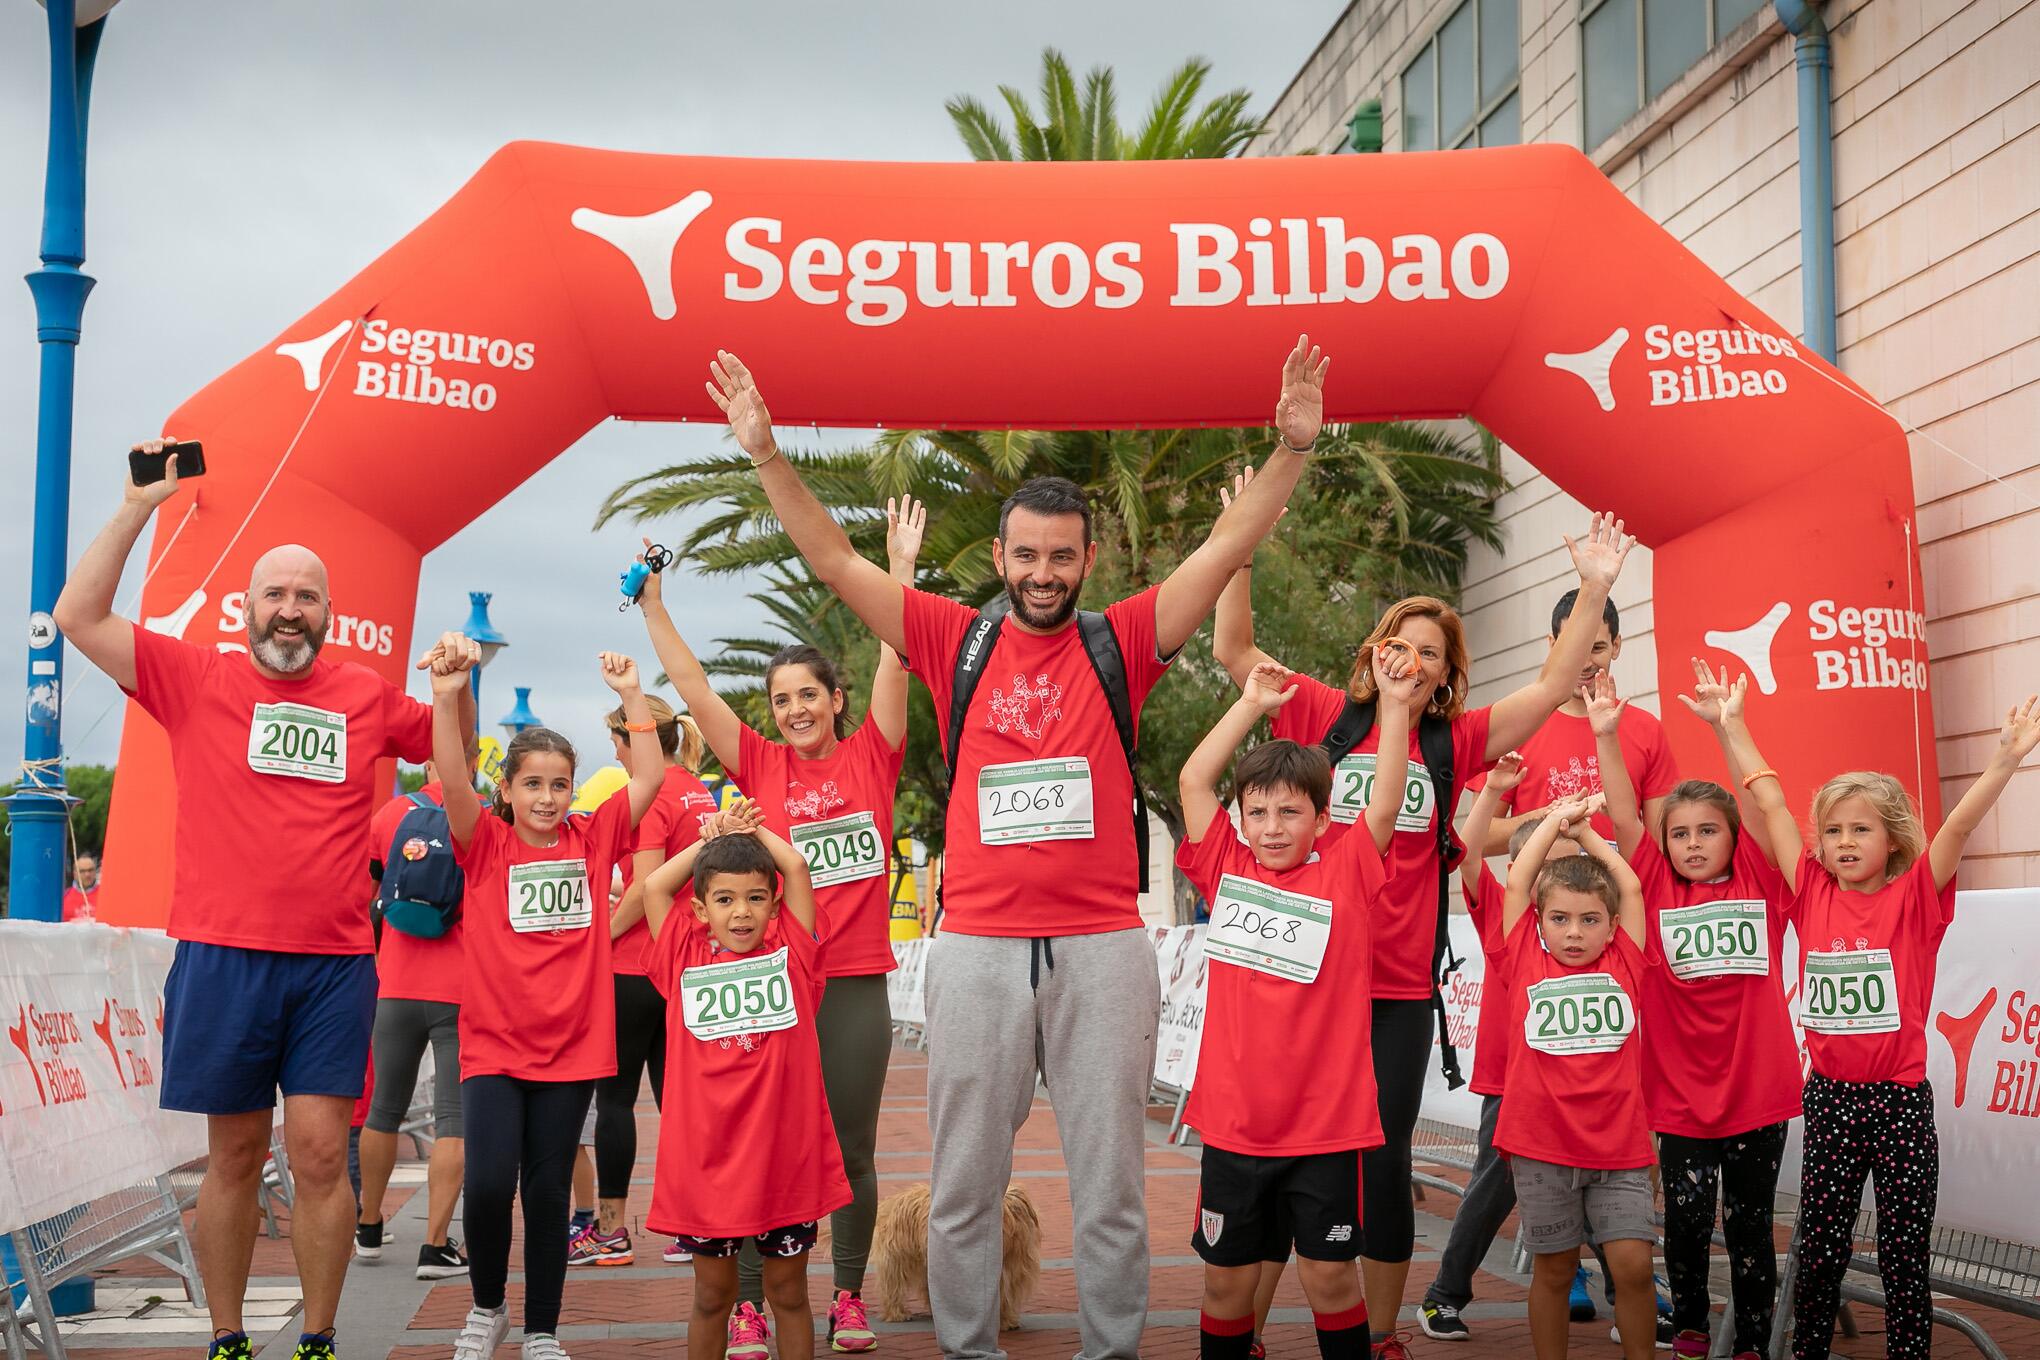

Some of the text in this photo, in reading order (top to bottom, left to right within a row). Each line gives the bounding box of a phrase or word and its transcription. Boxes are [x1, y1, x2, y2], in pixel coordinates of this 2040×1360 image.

[724, 216, 1510, 327] Seguros Bilbao
[360, 319, 535, 371] Seguros
[1644, 324, 1798, 365] Seguros
[353, 361, 497, 412] Bilbao
[1648, 364, 1788, 406] Bilbao
[218, 591, 393, 656] Sros
[1808, 599, 1927, 647] Seguro
[963, 619, 992, 671] HEAD
[1812, 646, 1927, 691] Bilbao
[261, 722, 337, 764] 2004
[990, 784, 1064, 816] 2068
[804, 830, 876, 872] 2049
[520, 879, 584, 915] 2004
[1221, 903, 1302, 943] 2068
[1672, 921, 1758, 961] 2050
[696, 974, 788, 1023] 2050
[1808, 973, 1886, 1016] 2050
[1535, 995, 1624, 1037] 2050
